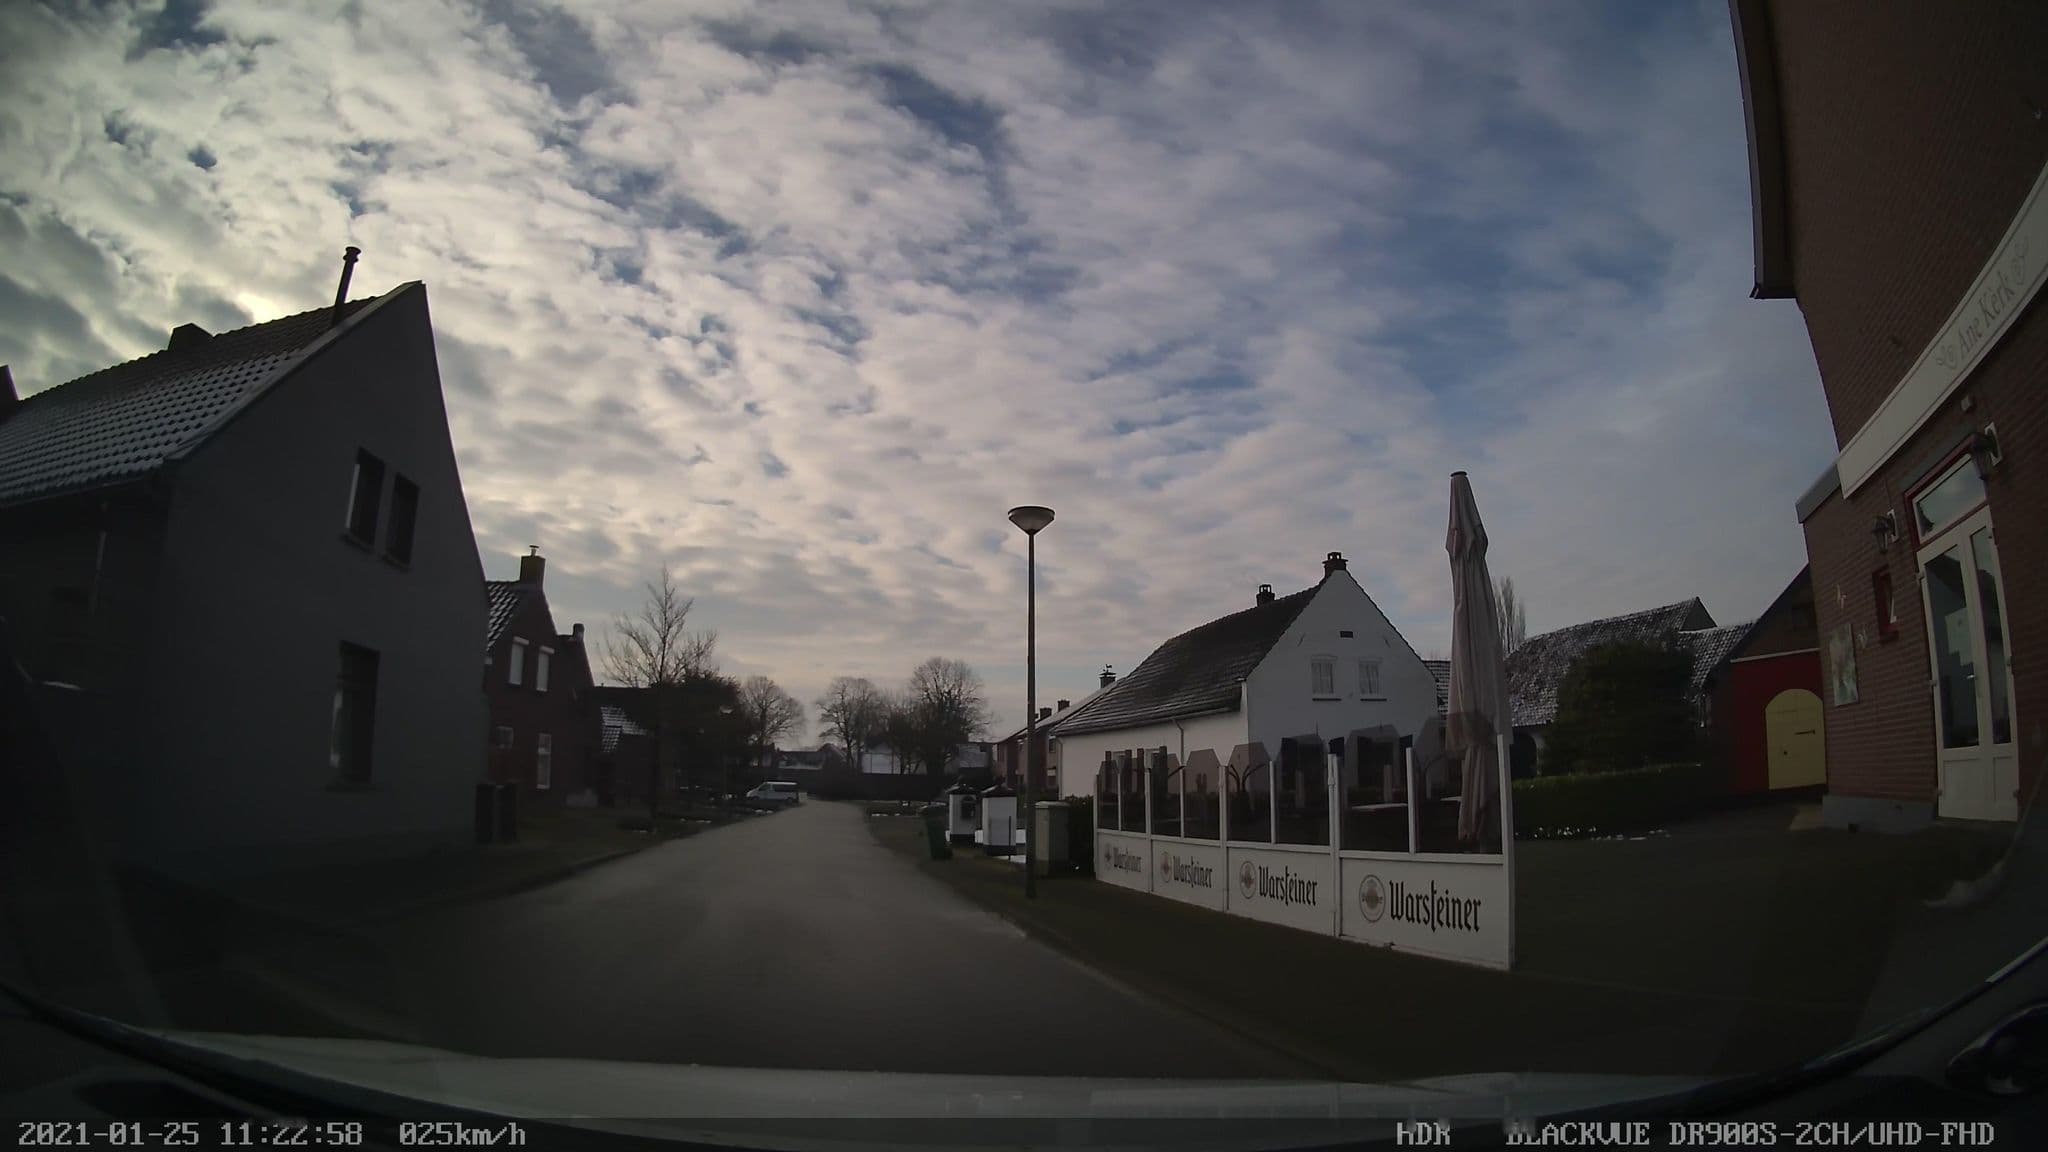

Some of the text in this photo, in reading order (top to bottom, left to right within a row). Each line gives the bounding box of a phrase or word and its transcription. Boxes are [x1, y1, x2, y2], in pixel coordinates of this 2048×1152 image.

[1978, 269, 2014, 329] Kerk
[1173, 856, 1213, 889] Warsteiner
[1259, 865, 1317, 906] Warsteiner
[1389, 880, 1481, 932] Warsteiner
